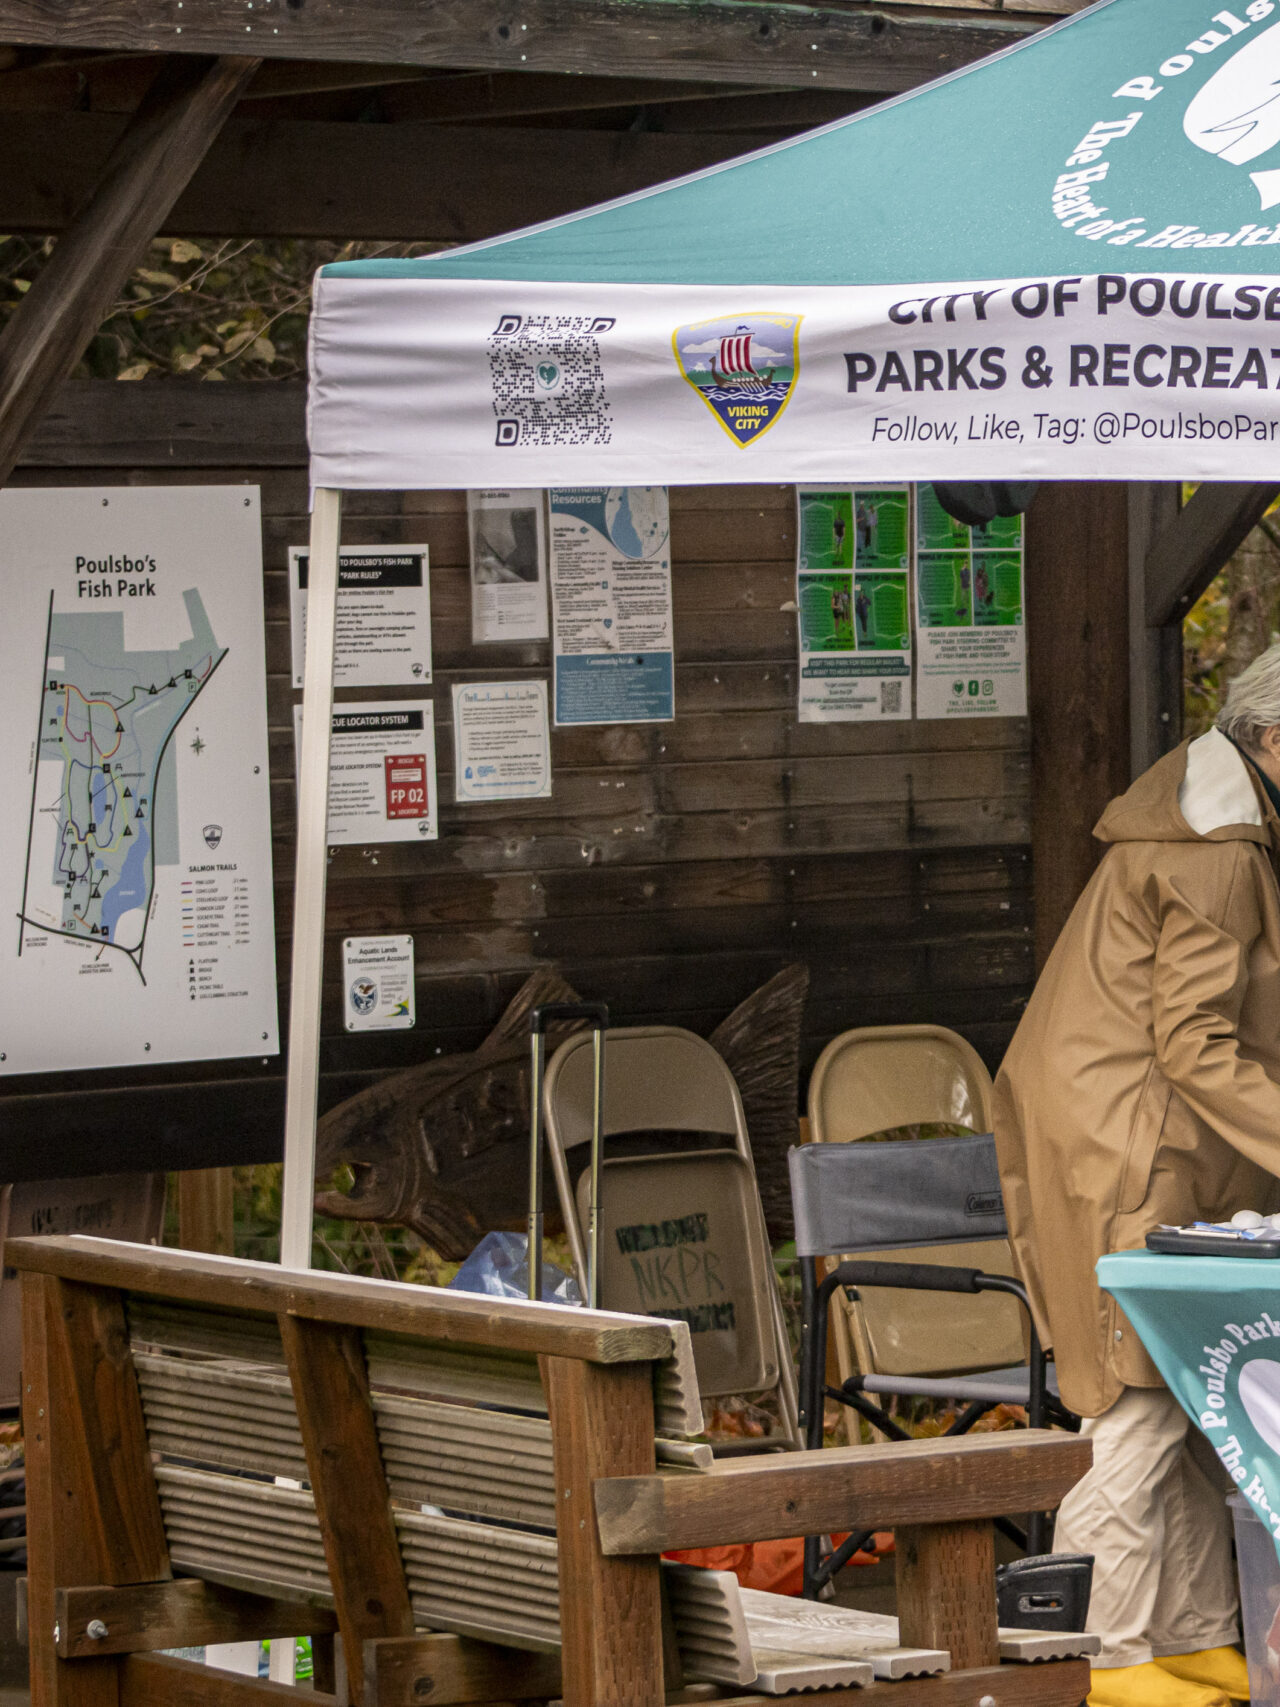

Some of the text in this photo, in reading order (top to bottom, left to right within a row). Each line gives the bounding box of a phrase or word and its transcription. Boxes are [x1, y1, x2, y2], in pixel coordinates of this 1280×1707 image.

[1065, 112, 1143, 167] The
[1052, 162, 1110, 228] Heart
[1075, 217, 1146, 240] of
[1107, 229, 1147, 245] a
[888, 288, 1007, 325] CITY
[1011, 278, 1083, 317] OF
[844, 347, 1006, 393] PARKS
[1021, 345, 1053, 389] &
[727, 405, 769, 417] VIKING
[735, 418, 761, 430] CITY
[871, 415, 959, 443] Follow,
[967, 414, 1024, 442] Like,
[1033, 413, 1086, 443] Tag:
[552, 495, 602, 504] Resources
[76, 554, 156, 574] Poulsbo's
[78, 578, 156, 598] Fish Park
[331, 715, 409, 727] CUE LOCATOR SYSTEM
[391, 788, 424, 803] FP 02
[387, 954, 410, 962] Account
[1200, 1337, 1238, 1429] Poulsbo
